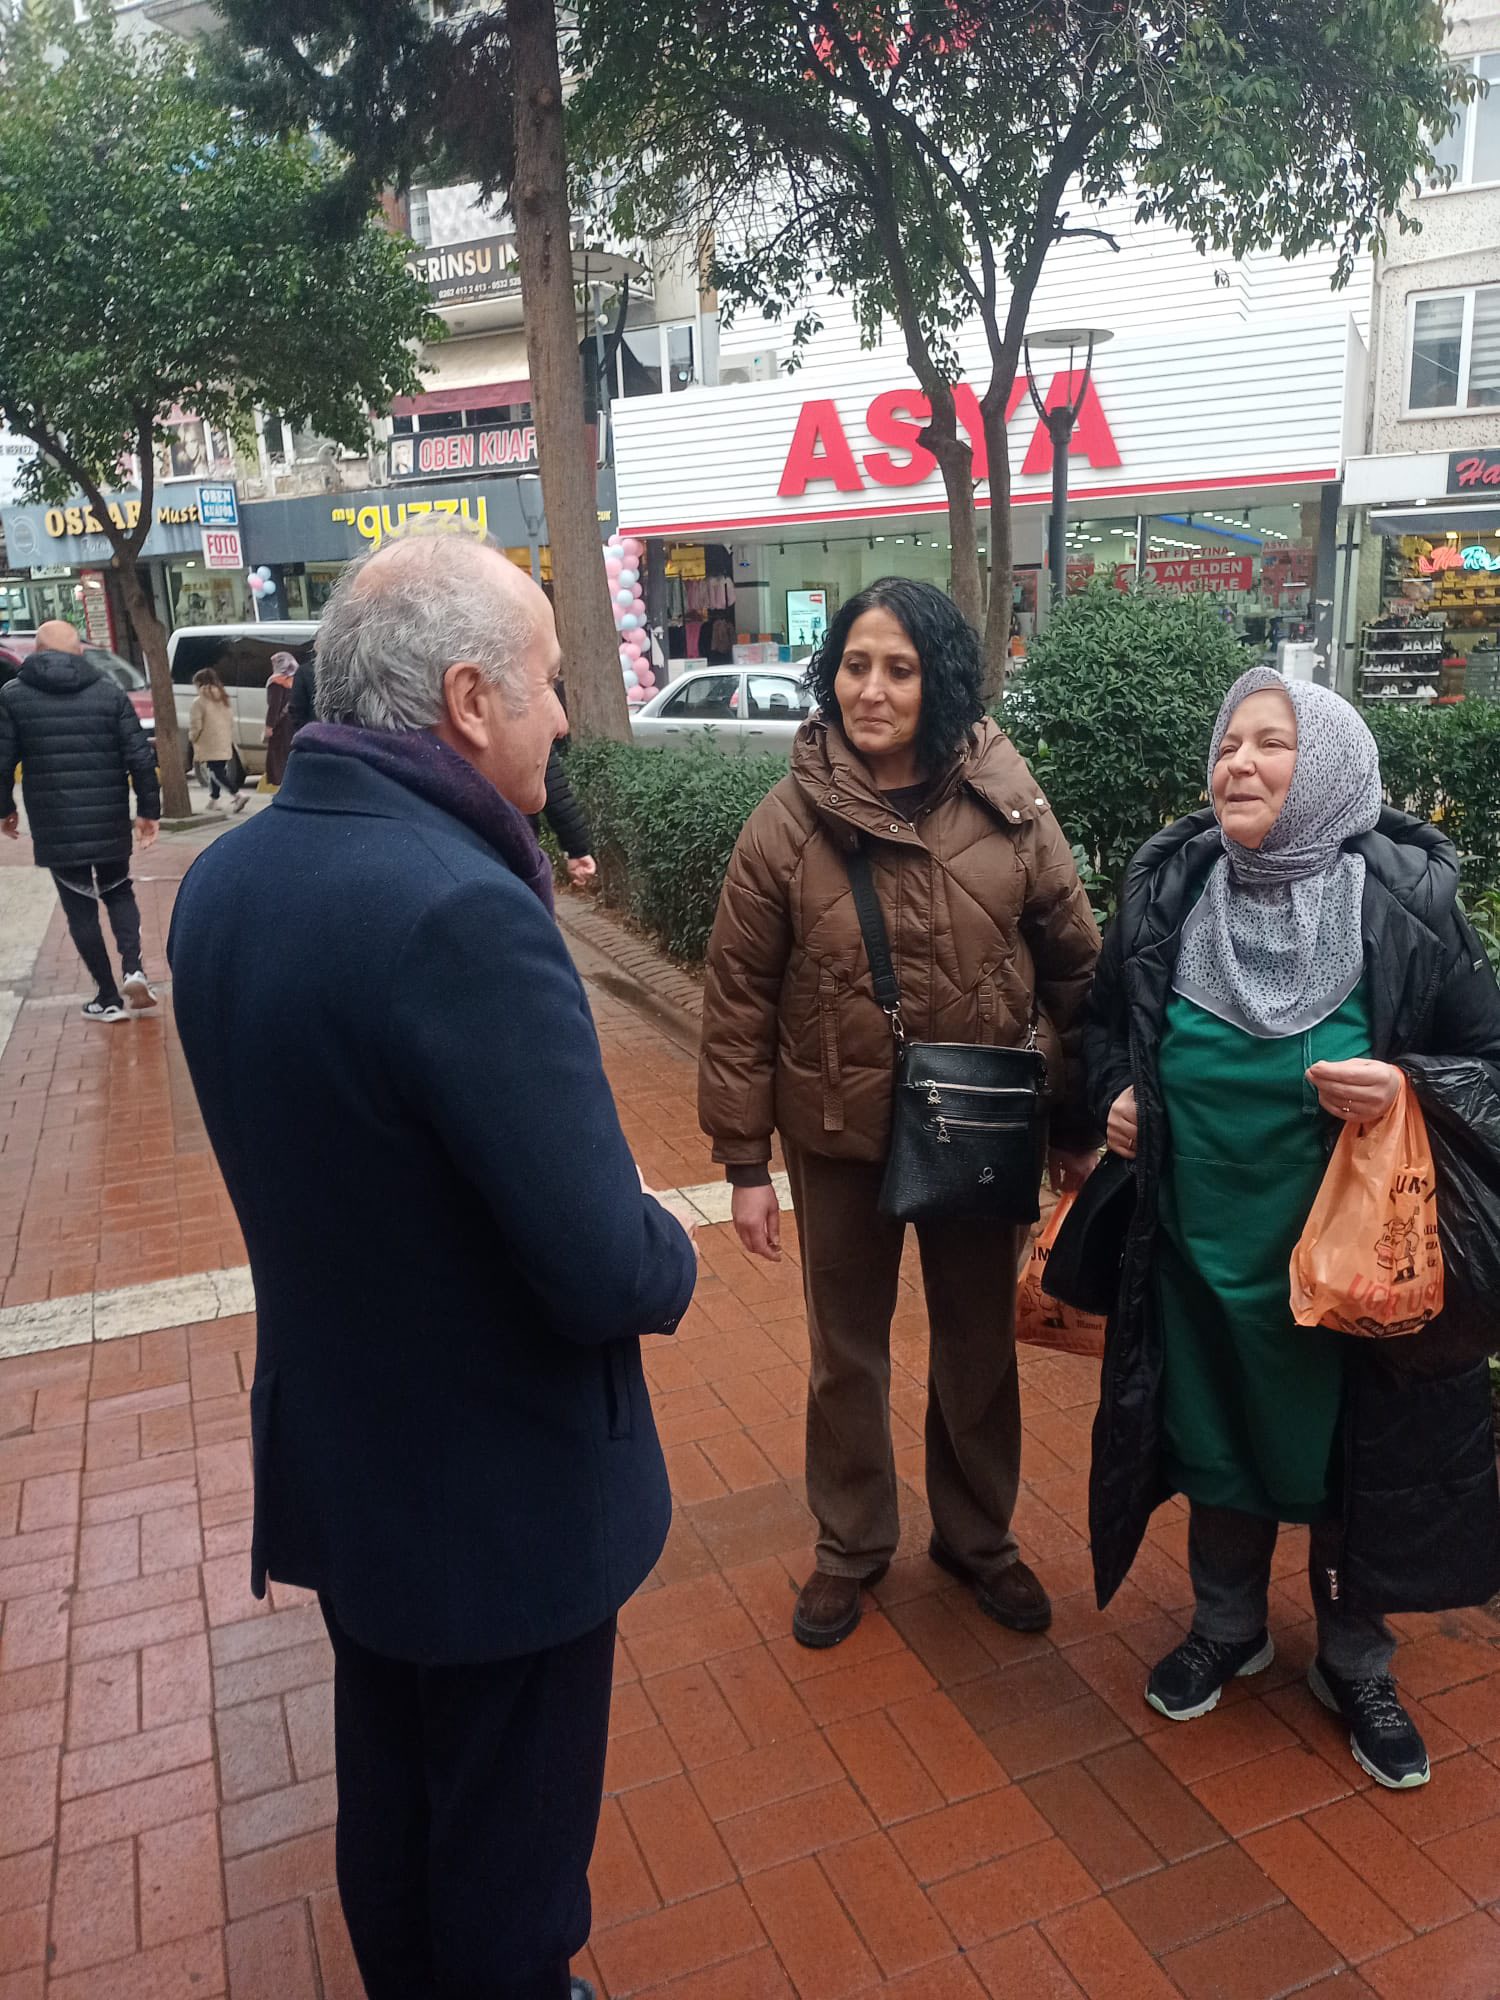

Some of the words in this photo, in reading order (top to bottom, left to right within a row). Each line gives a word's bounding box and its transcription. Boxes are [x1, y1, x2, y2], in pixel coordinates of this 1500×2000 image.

[777, 369, 1123, 497] ASYA
[419, 434, 473, 472] OBEN
[332, 507, 355, 526] my
[357, 496, 488, 551] guzzy
[206, 534, 238, 555] FOTO
[1164, 564, 1186, 579] AY
[1190, 560, 1243, 577] ELDEN
